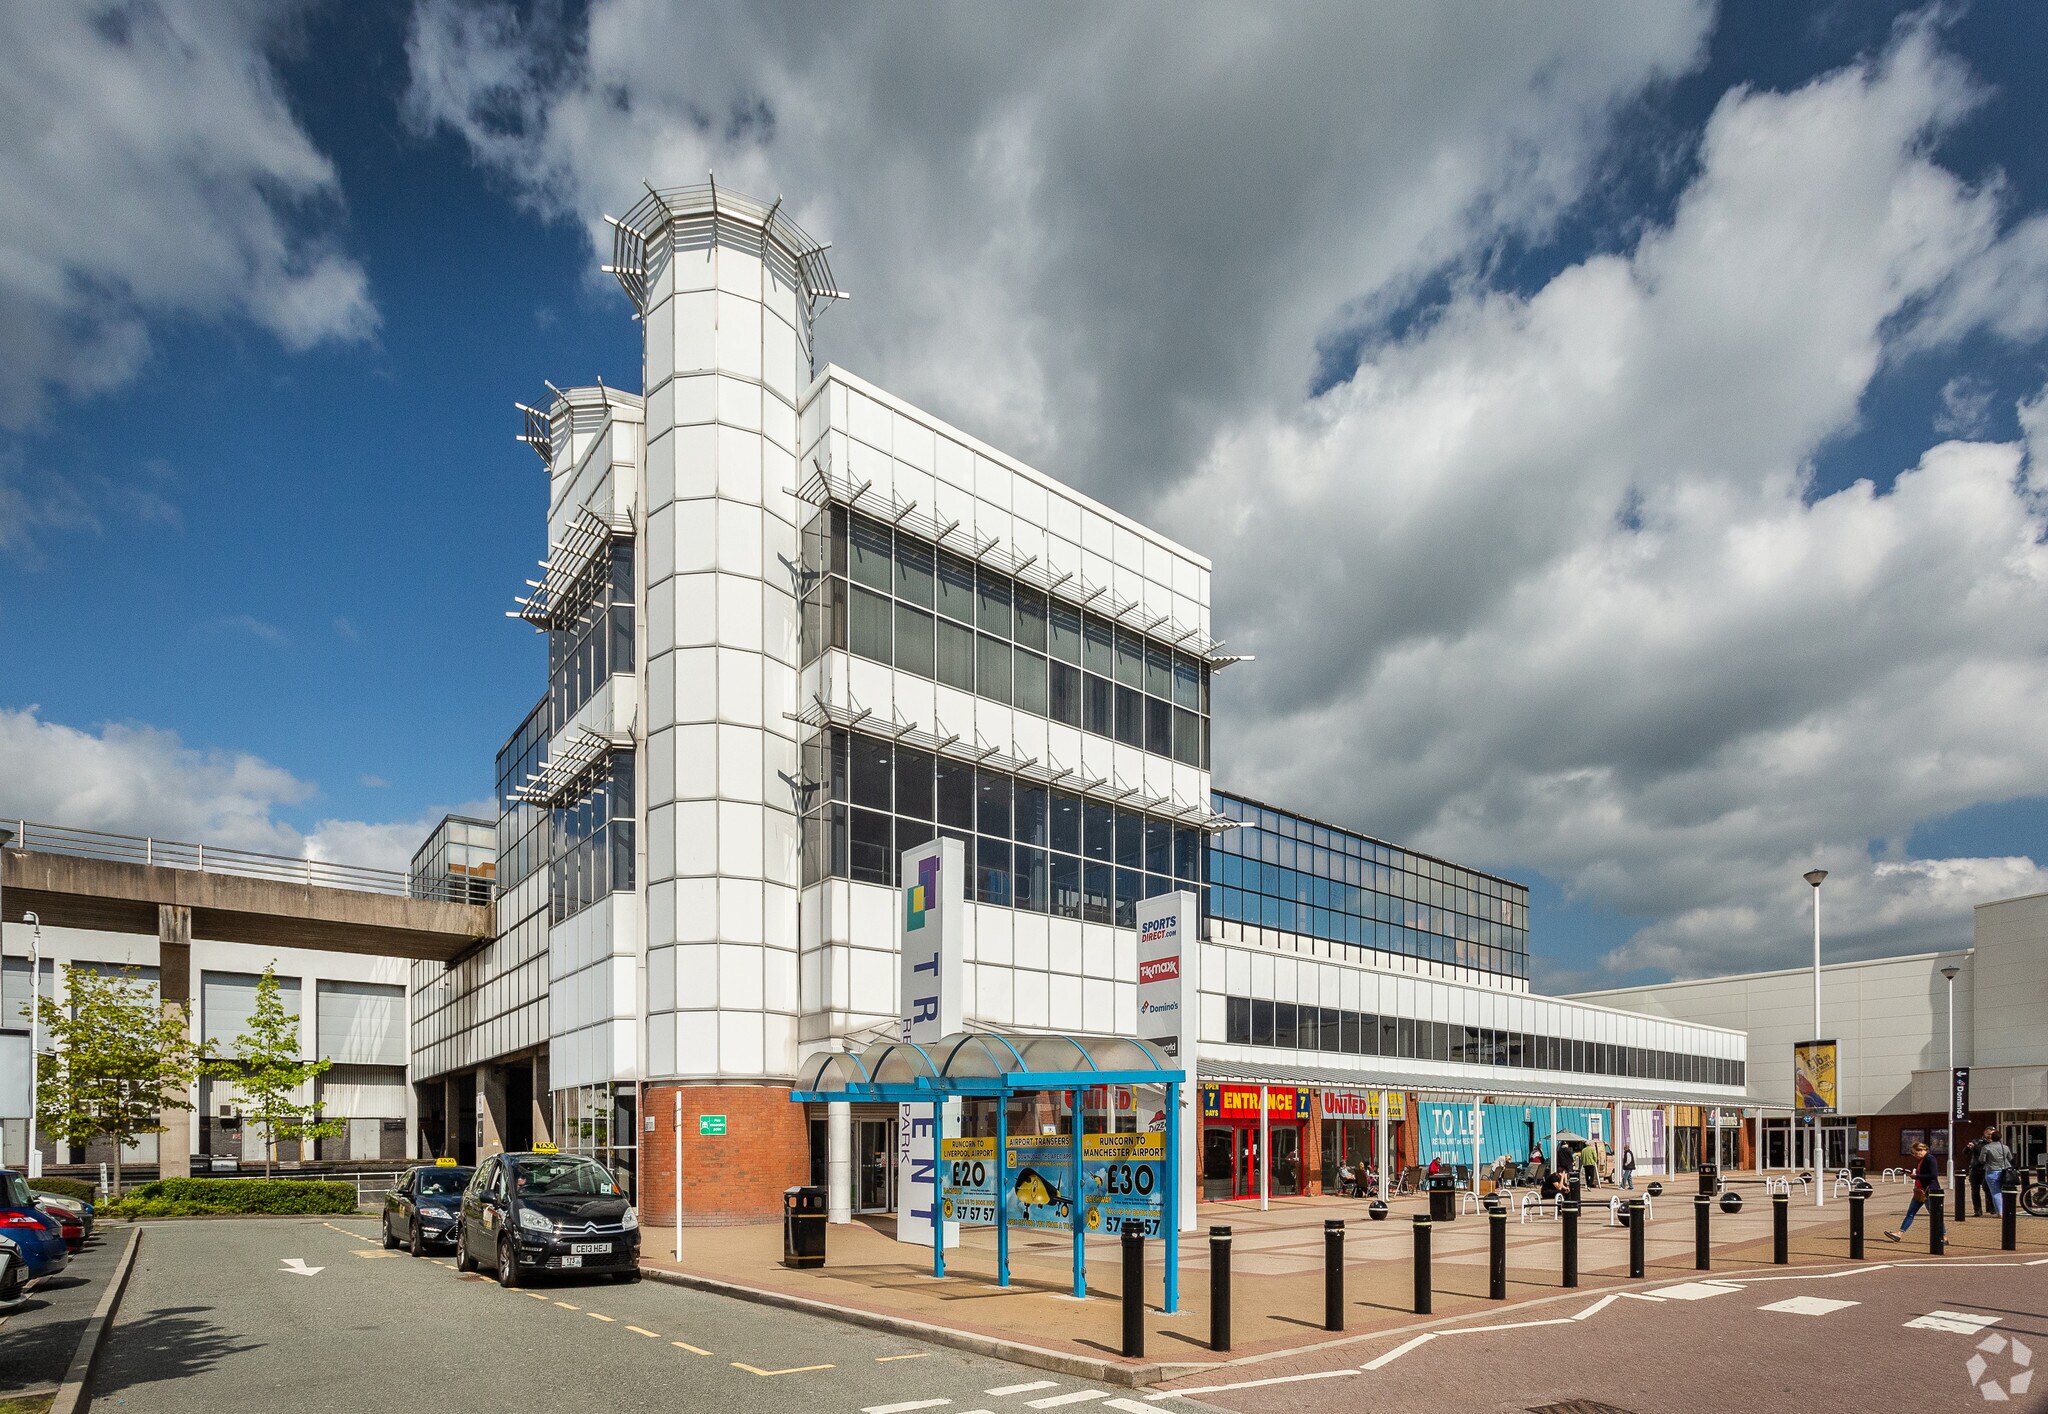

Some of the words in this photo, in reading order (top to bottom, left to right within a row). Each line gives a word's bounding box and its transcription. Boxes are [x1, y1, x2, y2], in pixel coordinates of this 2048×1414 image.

[1142, 916, 1176, 933] SPORTS
[1150, 1002, 1178, 1014] Domino's
[1209, 1092, 1215, 1106] 7
[1300, 1096, 1306, 1109] 7
[1432, 1110, 1454, 1136] TO
[902, 1104, 910, 1163] PARK
[1100, 1137, 1134, 1145] RUNCORN
[1136, 1136, 1145, 1144] TO
[952, 1140, 976, 1148] RUNCORN
[1010, 1138, 1033, 1146] AIRPORT
[1034, 1137, 1070, 1146] TRANSFERS
[1084, 1148, 1132, 1157] MANCHESTER
[1132, 1148, 1164, 1156] AIRPORT
[953, 1161, 985, 1187] £20
[1108, 1164, 1154, 1195] £30
[957, 1206, 967, 1219] 57
[970, 1207, 981, 1220] 57
[984, 1208, 994, 1221] 57
[1106, 1217, 1121, 1232] 57
[1145, 1219, 1160, 1235] 57
